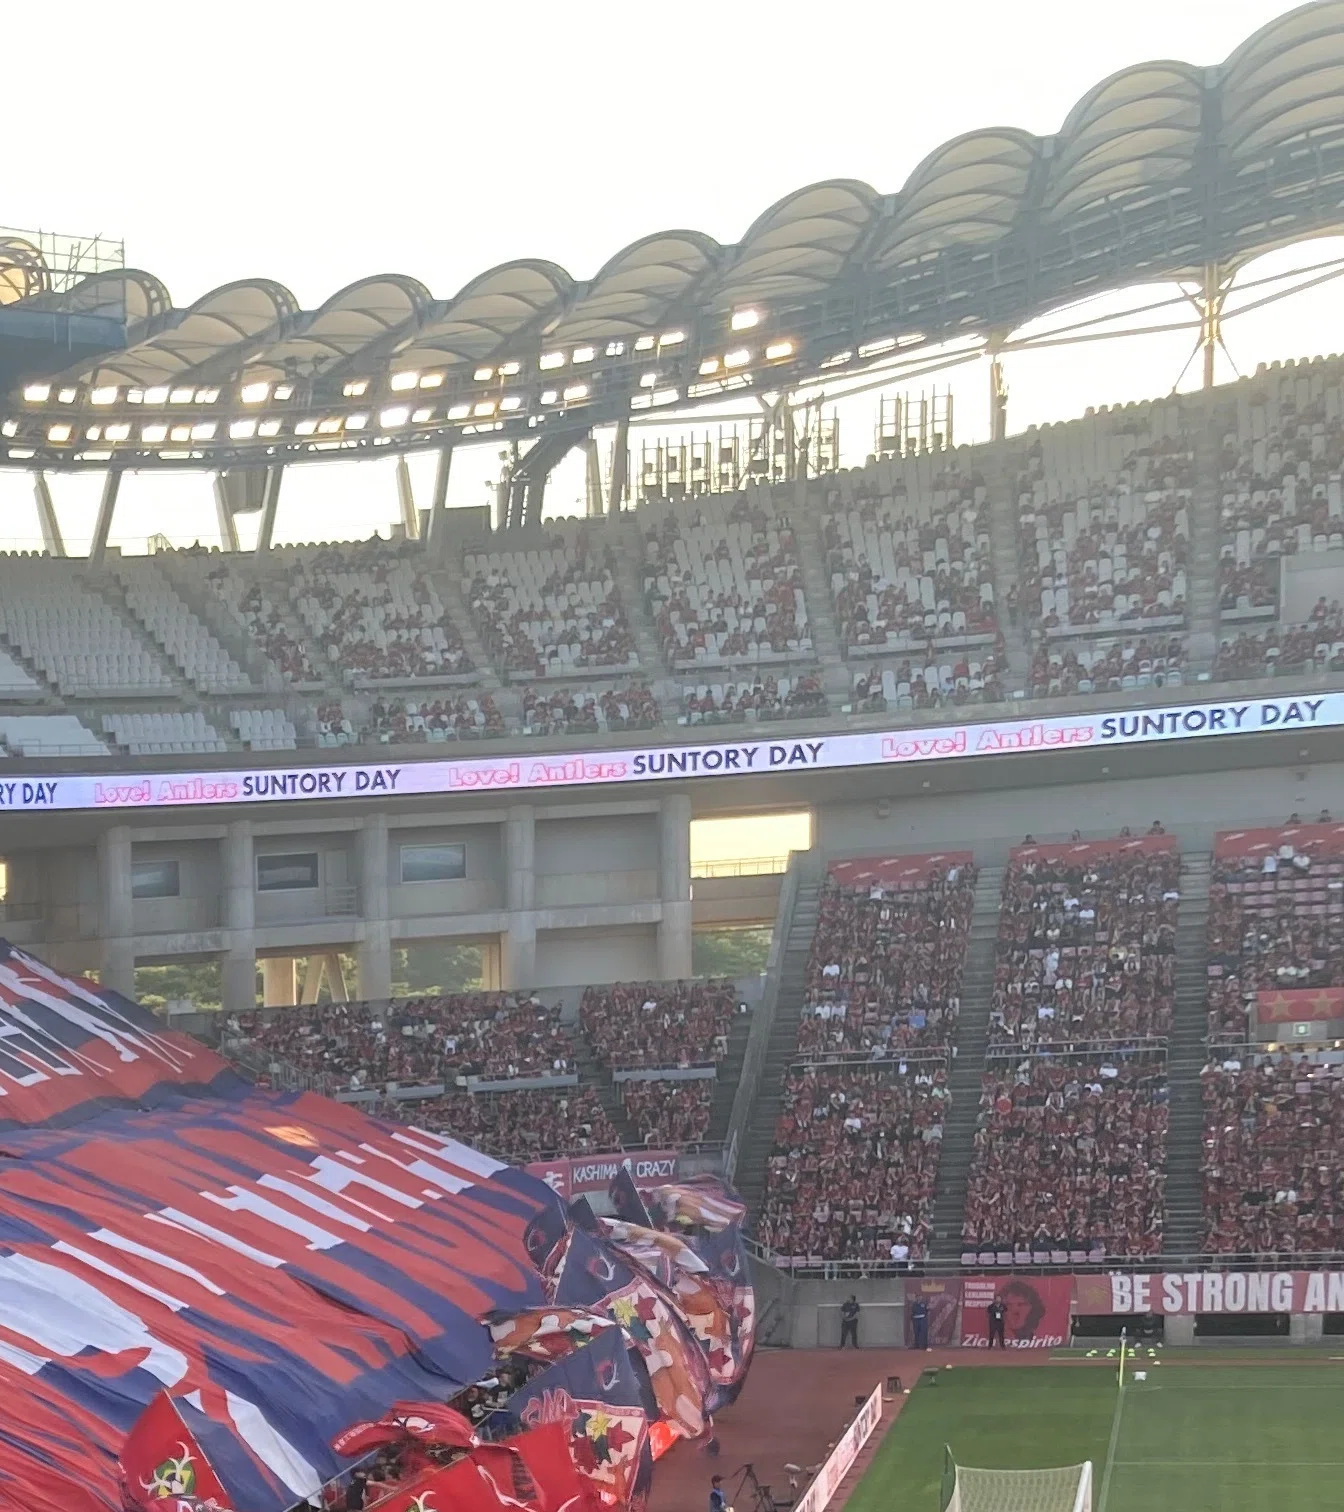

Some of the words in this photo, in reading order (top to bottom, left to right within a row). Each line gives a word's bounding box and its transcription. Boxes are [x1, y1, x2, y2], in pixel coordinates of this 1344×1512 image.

[881, 730, 967, 758] Love!
[976, 723, 1095, 752] Antlers
[1100, 705, 1249, 739] SUNTORY
[1260, 698, 1325, 726] DAY
[449, 762, 521, 788] Love!
[527, 758, 628, 784] Antlers
[632, 745, 760, 776] SUNTORY
[768, 741, 825, 768] DAY
[20, 781, 59, 806] DAY
[242, 771, 349, 798] SUNTORY
[354, 768, 402, 792] DAY
[571, 1162, 619, 1184] KASHIMA
[635, 1158, 676, 1178] CRAZY
[1111, 1274, 1152, 1313] BE
[1161, 1271, 1294, 1313] STRONG
